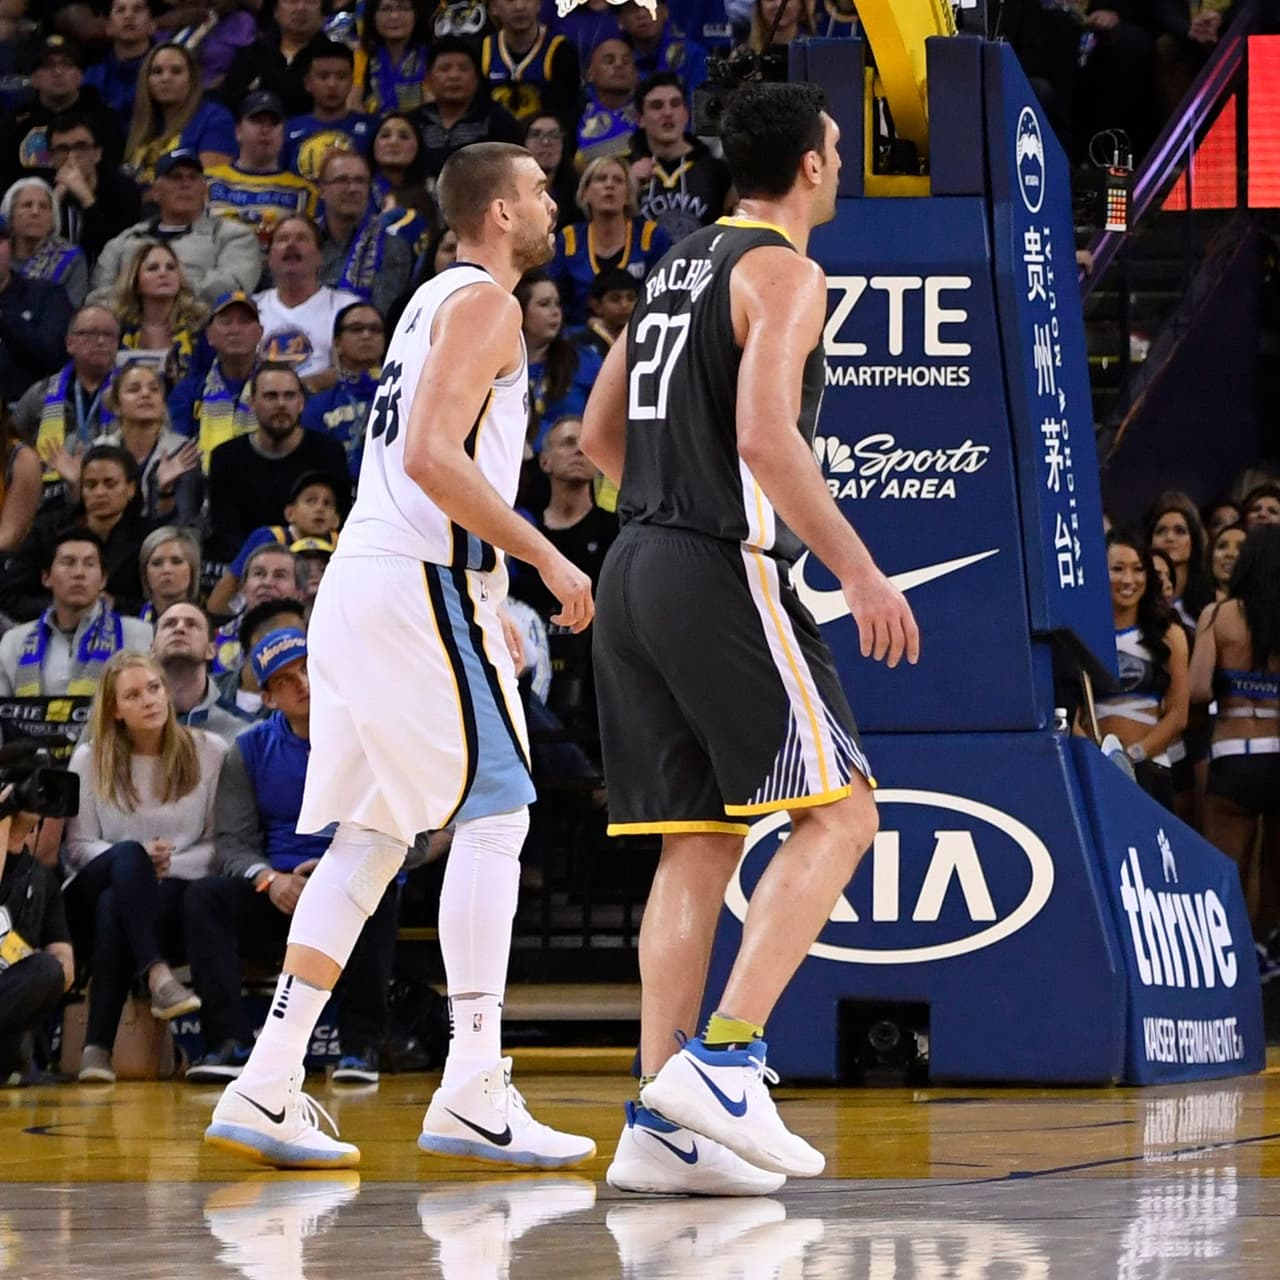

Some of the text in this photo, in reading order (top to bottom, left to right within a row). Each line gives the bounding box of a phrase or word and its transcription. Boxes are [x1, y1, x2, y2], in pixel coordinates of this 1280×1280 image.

[640, 191, 708, 220] TOWN
[825, 275, 972, 357] ZTE
[628, 312, 691, 420] 27
[825, 365, 971, 388] MARTPHONES
[1022, 225, 1075, 589] 贵州茅台
[854, 432, 991, 485] Sports
[826, 478, 957, 500] BAY AREA
[1119, 846, 1239, 990] thrive
[1142, 1016, 1176, 1063] KAISER
